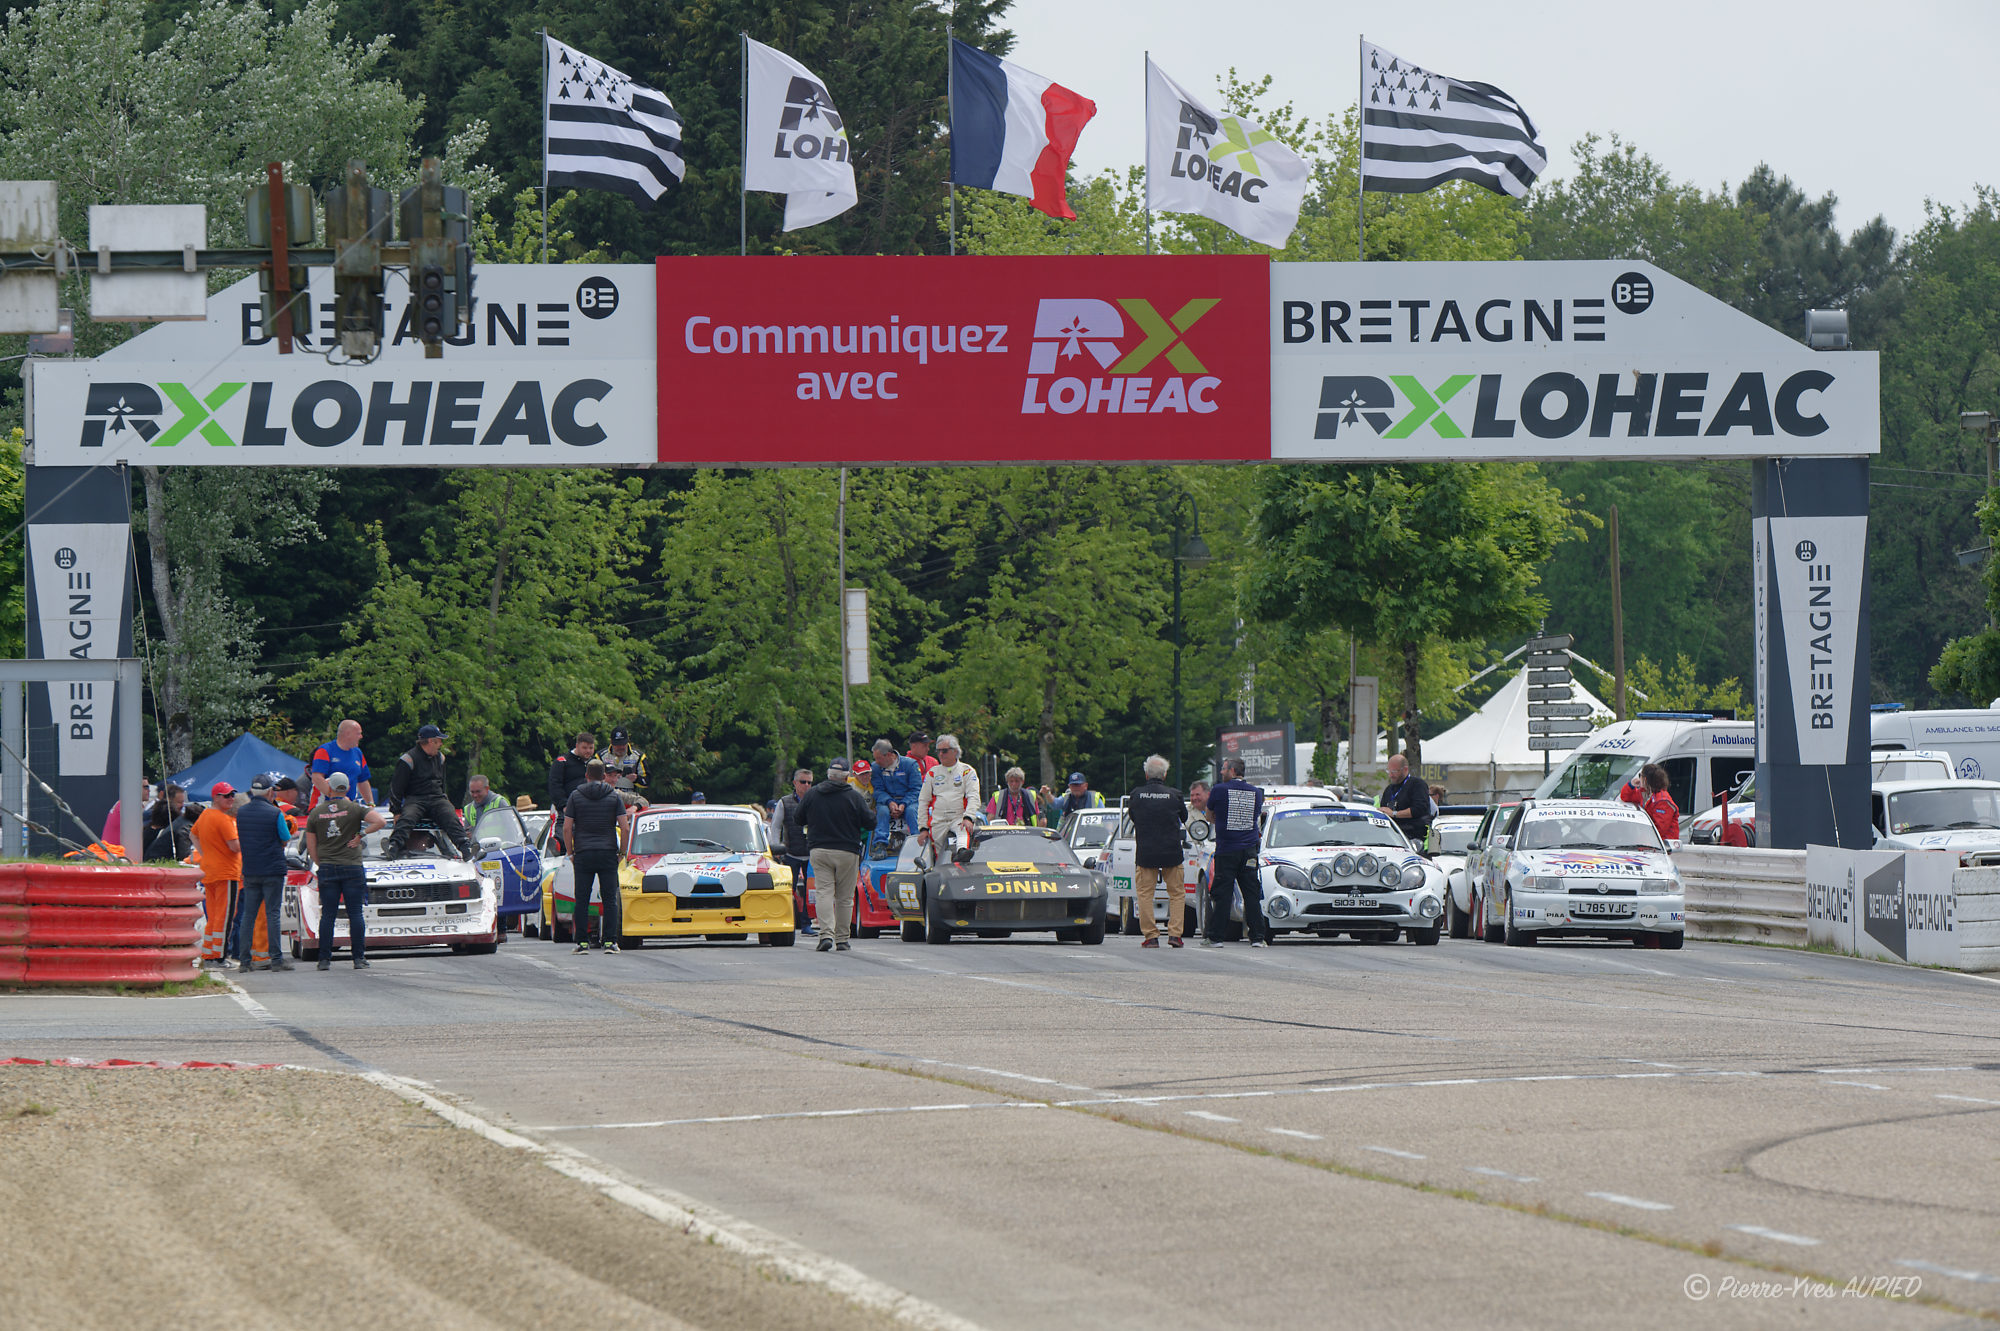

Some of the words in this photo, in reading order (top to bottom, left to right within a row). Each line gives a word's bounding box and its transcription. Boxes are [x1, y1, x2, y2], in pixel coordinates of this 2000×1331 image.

[1282, 298, 1606, 343] BRETAGNE
[684, 315, 1009, 364] Communiquez
[1027, 298, 1222, 374] RX
[796, 368, 898, 400] avec
[1021, 376, 1222, 414] LOHEAC
[1809, 564, 1833, 730] BRETAGNE
[68, 572, 94, 740] BREAGNE
[1532, 723, 1551, 731] Quad
[1532, 740, 1559, 749] Karting
[1594, 738, 1636, 750] ASSU
[1712, 734, 1756, 745] Ambulanc
[1538, 809, 1566, 817] Mobil
[1579, 809, 1595, 817] 84
[889, 820, 903, 830] 24
[1085, 816, 1098, 824] 82
[640, 822, 655, 833] 25
[1563, 863, 1620, 871] Mobil
[899, 882, 920, 909] 53
[1334, 899, 1356, 907] S103
[1578, 904, 1606, 913] L785
[1608, 904, 1628, 913] VJC
[1808, 883, 1848, 923] BRETAGNE
[1869, 893, 1899, 920] BRETAGNE
[1907, 893, 1953, 931] BRETAGNE
[368, 925, 459, 935] PIONEER
